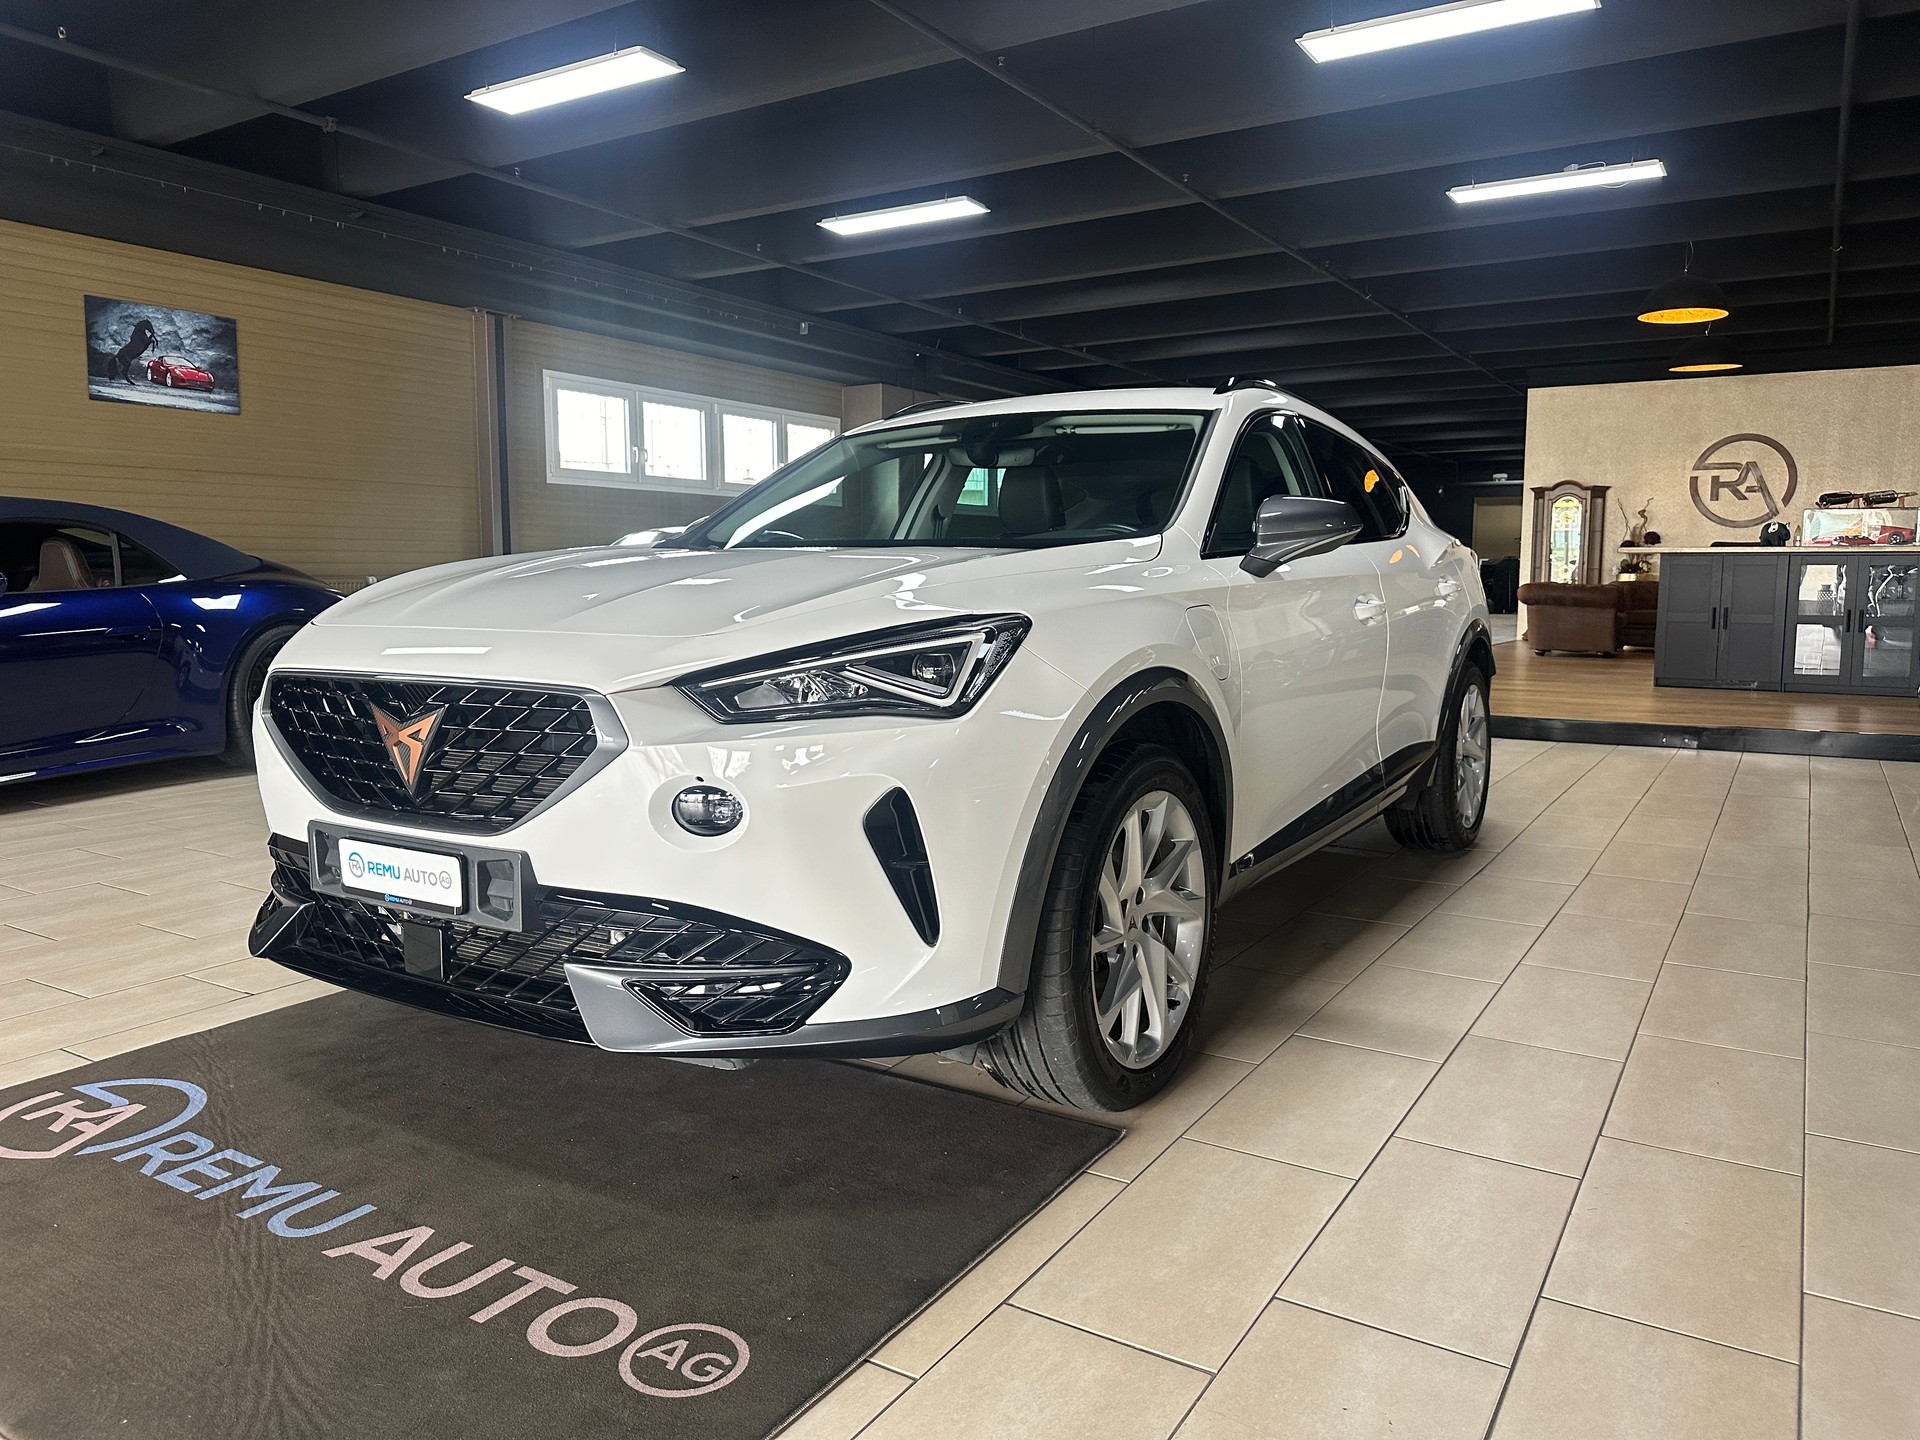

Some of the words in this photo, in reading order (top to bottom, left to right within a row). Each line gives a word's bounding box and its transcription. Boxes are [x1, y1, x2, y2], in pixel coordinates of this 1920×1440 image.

[367, 861, 401, 880] REMU
[403, 867, 438, 887] AUTO
[112, 1131, 378, 1238] REMU
[321, 1225, 638, 1358] AUTO
[636, 1338, 733, 1383] AG
